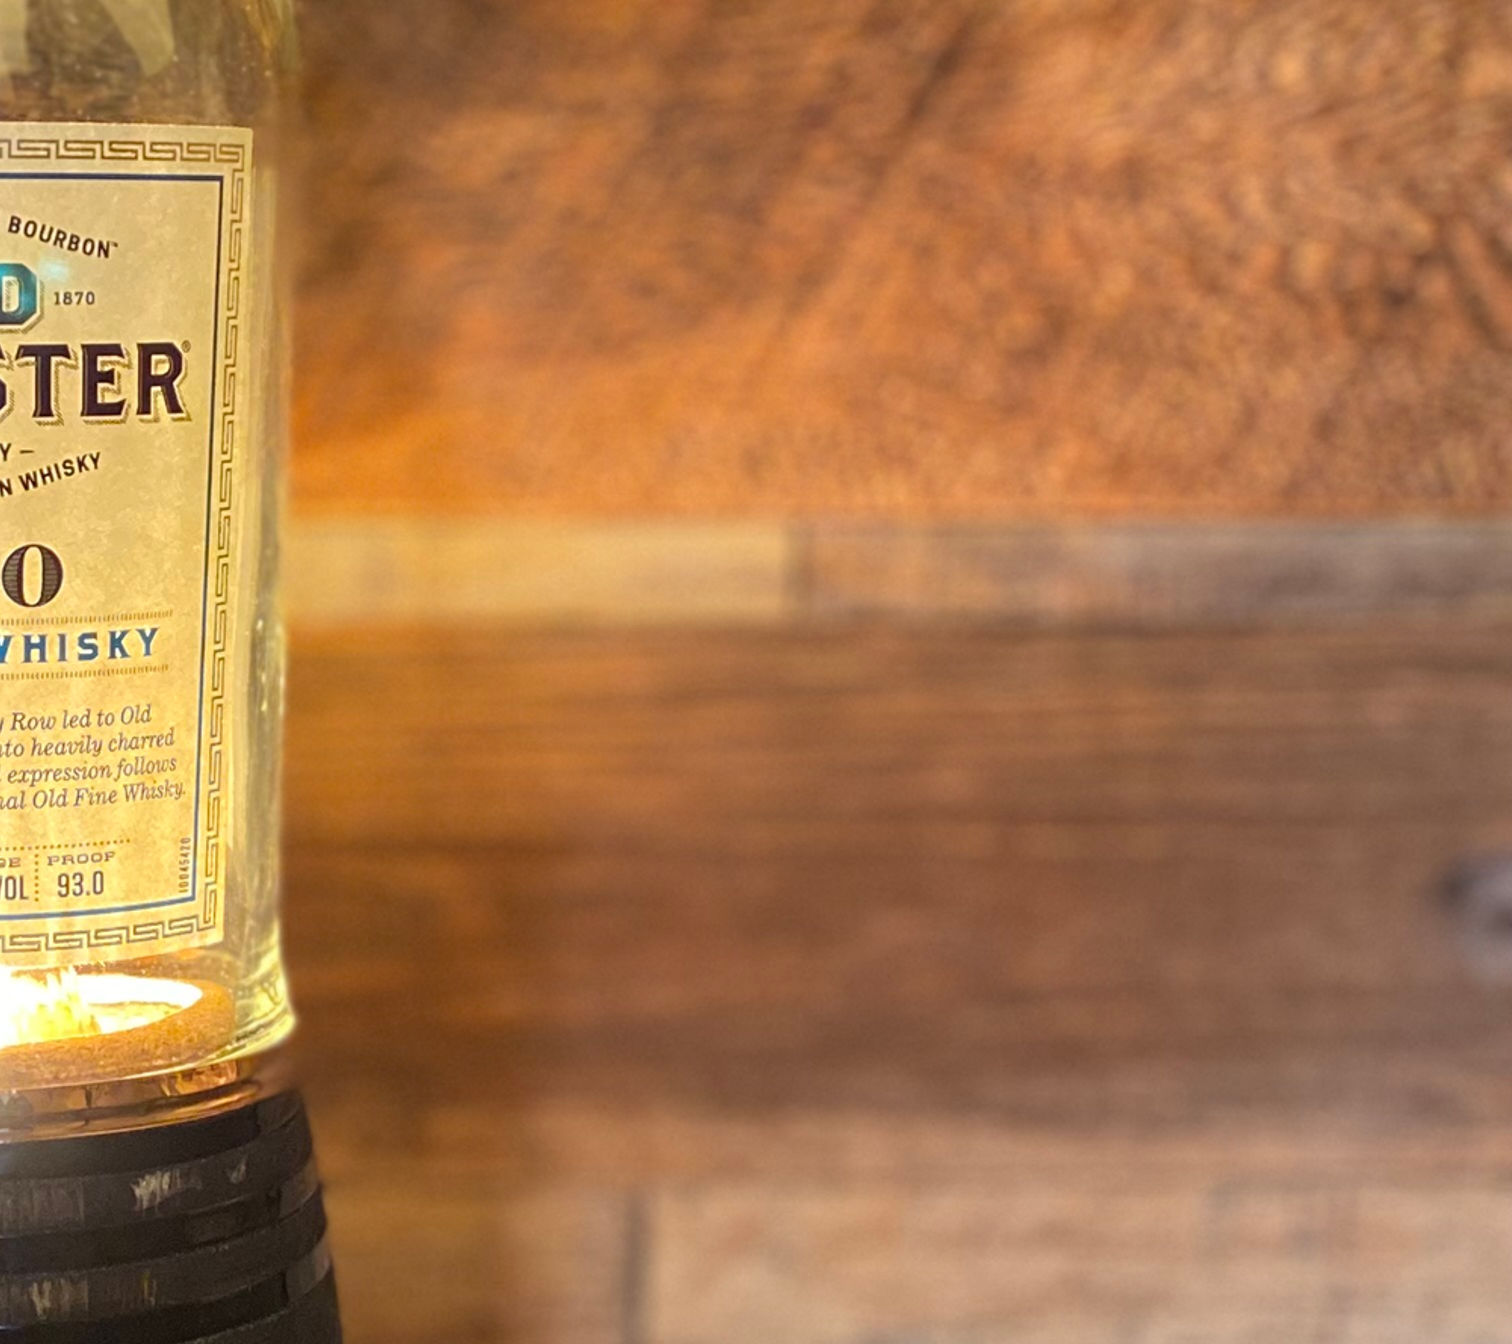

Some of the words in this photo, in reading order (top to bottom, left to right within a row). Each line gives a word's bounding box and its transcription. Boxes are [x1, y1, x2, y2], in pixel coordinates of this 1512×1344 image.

[53, 291, 96, 306] 1870
[18, 451, 102, 492] WHISKY
[11, 711, 57, 732] Row
[62, 709, 92, 730] led
[96, 709, 115, 727] to
[120, 704, 153, 725] Old
[31, 734, 103, 758] heavily
[107, 726, 175, 753] charred
[6, 761, 113, 788] expression
[113, 756, 178, 783] follows
[32, 787, 69, 809] Old
[73, 786, 118, 808] Fine
[122, 779, 186, 802] Whisky.
[47, 851, 116, 867] PROOF
[57, 870, 105, 898] 93.0
